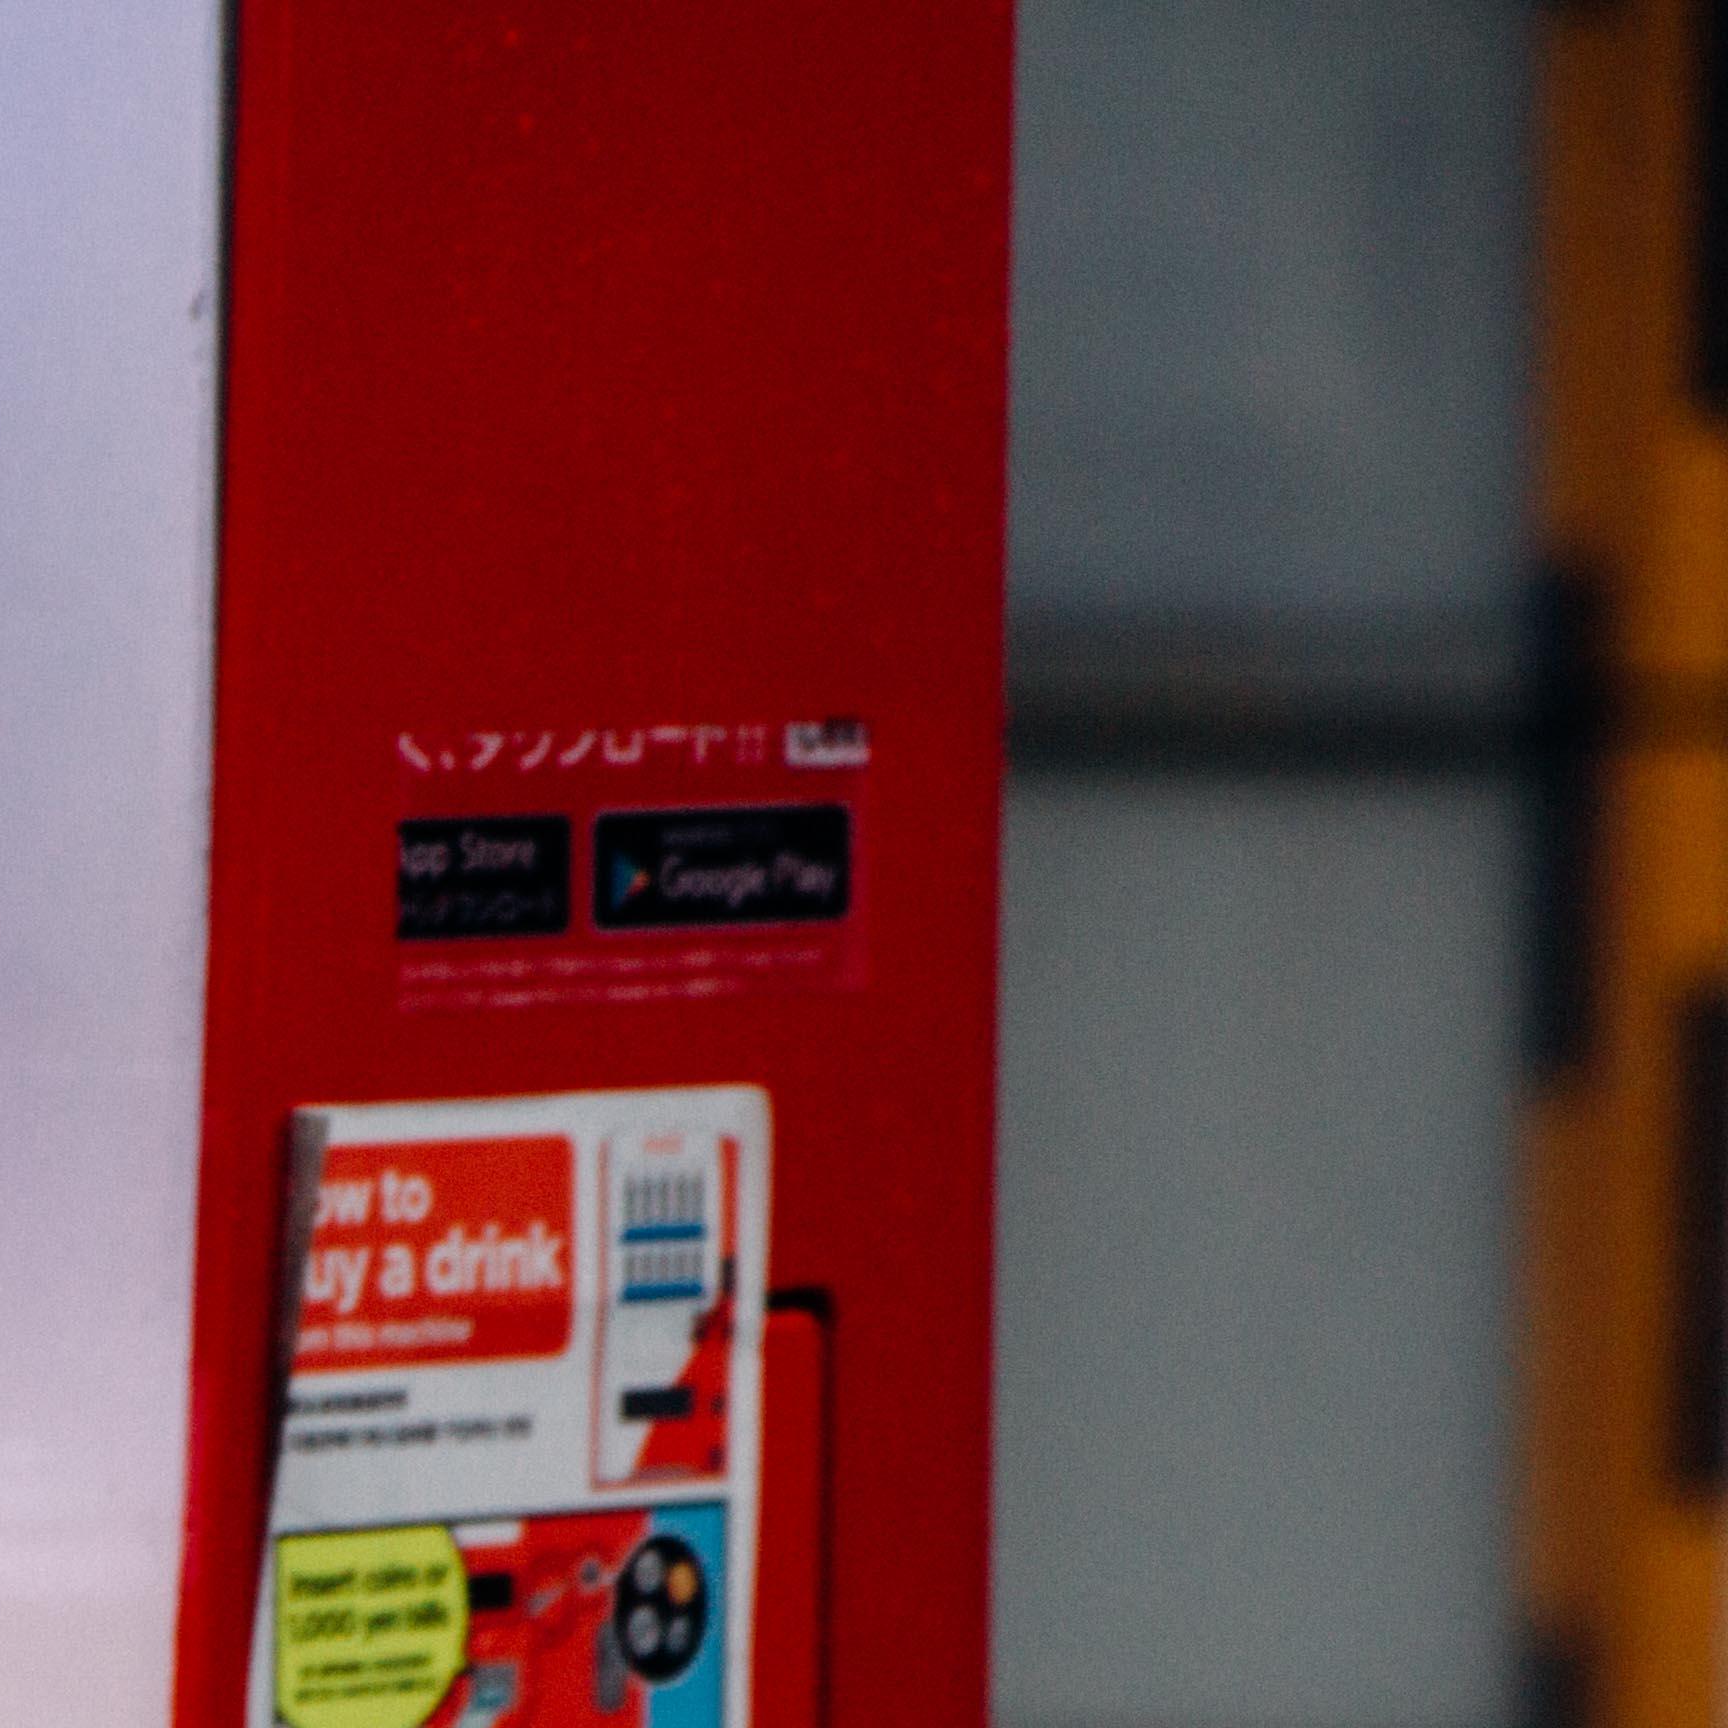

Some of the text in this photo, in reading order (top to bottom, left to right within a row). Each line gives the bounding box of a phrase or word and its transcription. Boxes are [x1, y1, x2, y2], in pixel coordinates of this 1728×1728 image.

[380, 1171, 434, 1223] to
[378, 1243, 417, 1298] a
[425, 1220, 564, 1294] drink
